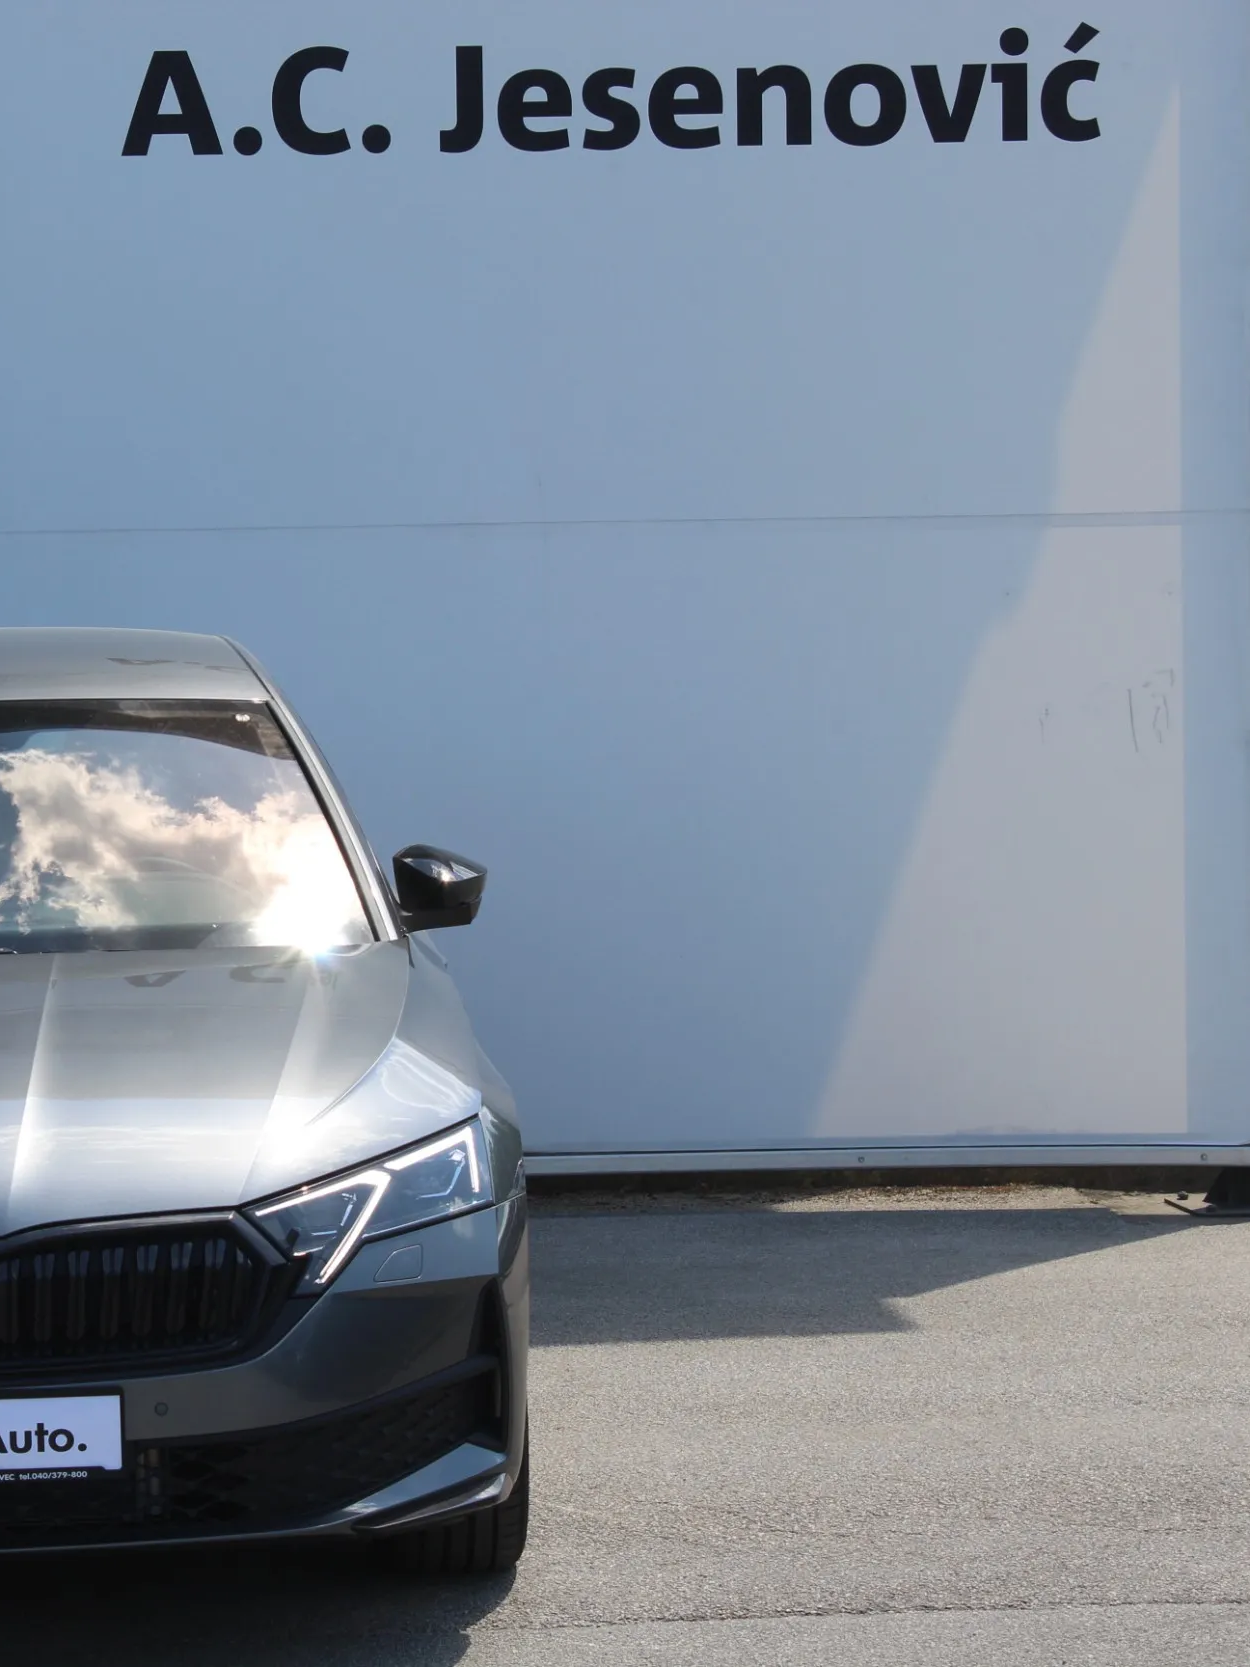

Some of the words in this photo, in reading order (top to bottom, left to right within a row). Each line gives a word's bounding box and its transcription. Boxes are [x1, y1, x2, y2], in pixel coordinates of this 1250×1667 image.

[121, 45, 392, 157] A.C.
[439, 21, 1101, 154] Jesenović
[18, 1470, 89, 1481] tel.040/379-800
